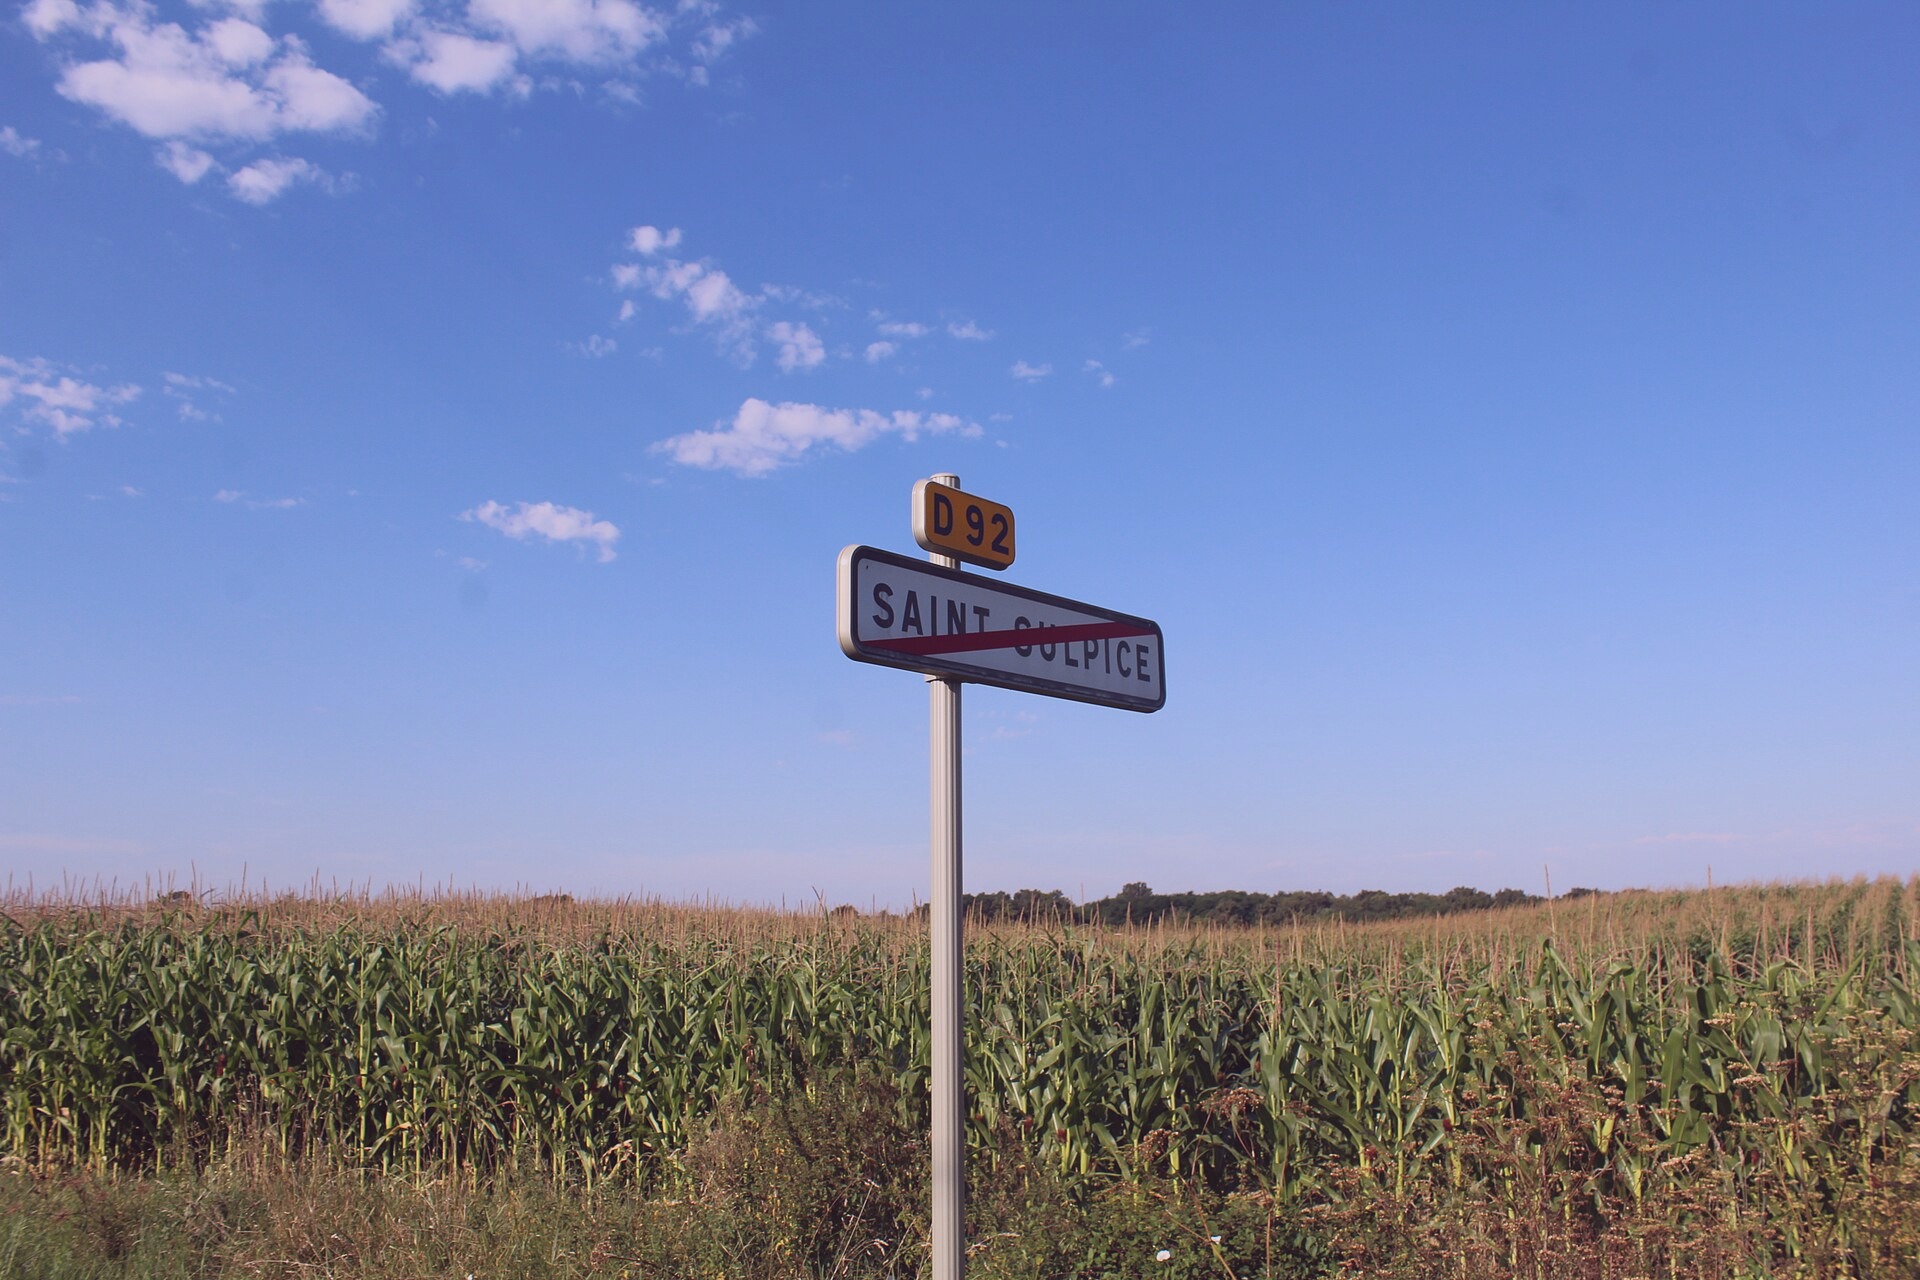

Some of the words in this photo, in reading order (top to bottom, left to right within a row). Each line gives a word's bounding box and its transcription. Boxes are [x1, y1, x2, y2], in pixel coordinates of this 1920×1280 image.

[934, 493, 953, 536] D
[966, 504, 1009, 555] 92
[872, 582, 990, 639] SAINT
[1014, 616, 1151, 682] SULPICE
